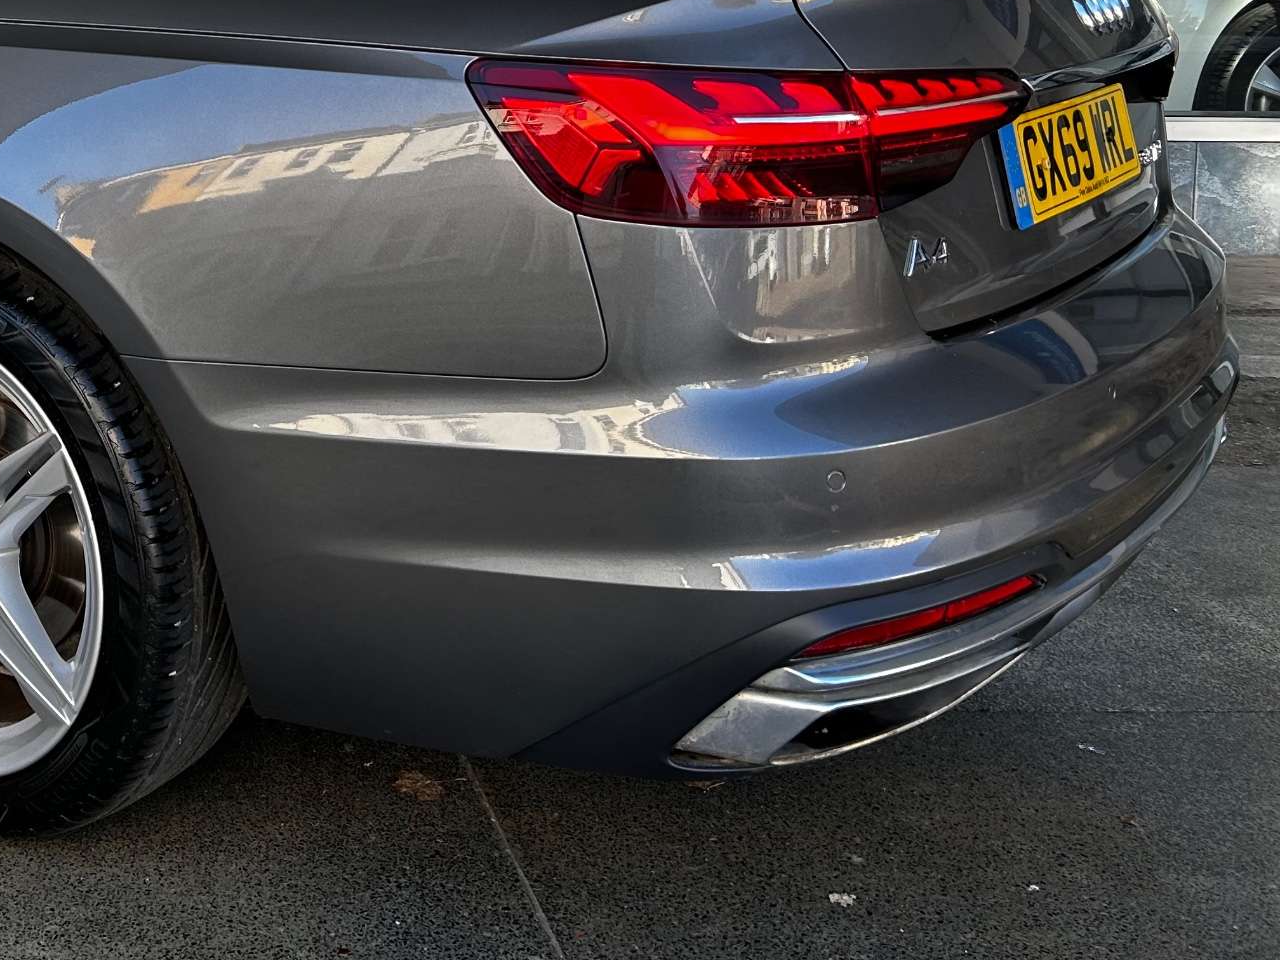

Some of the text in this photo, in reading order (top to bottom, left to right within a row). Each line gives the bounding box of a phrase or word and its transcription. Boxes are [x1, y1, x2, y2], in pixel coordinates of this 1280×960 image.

[1022, 108, 1095, 202] GX69
[1015, 186, 1028, 209] GB
[903, 236, 951, 278] A4
